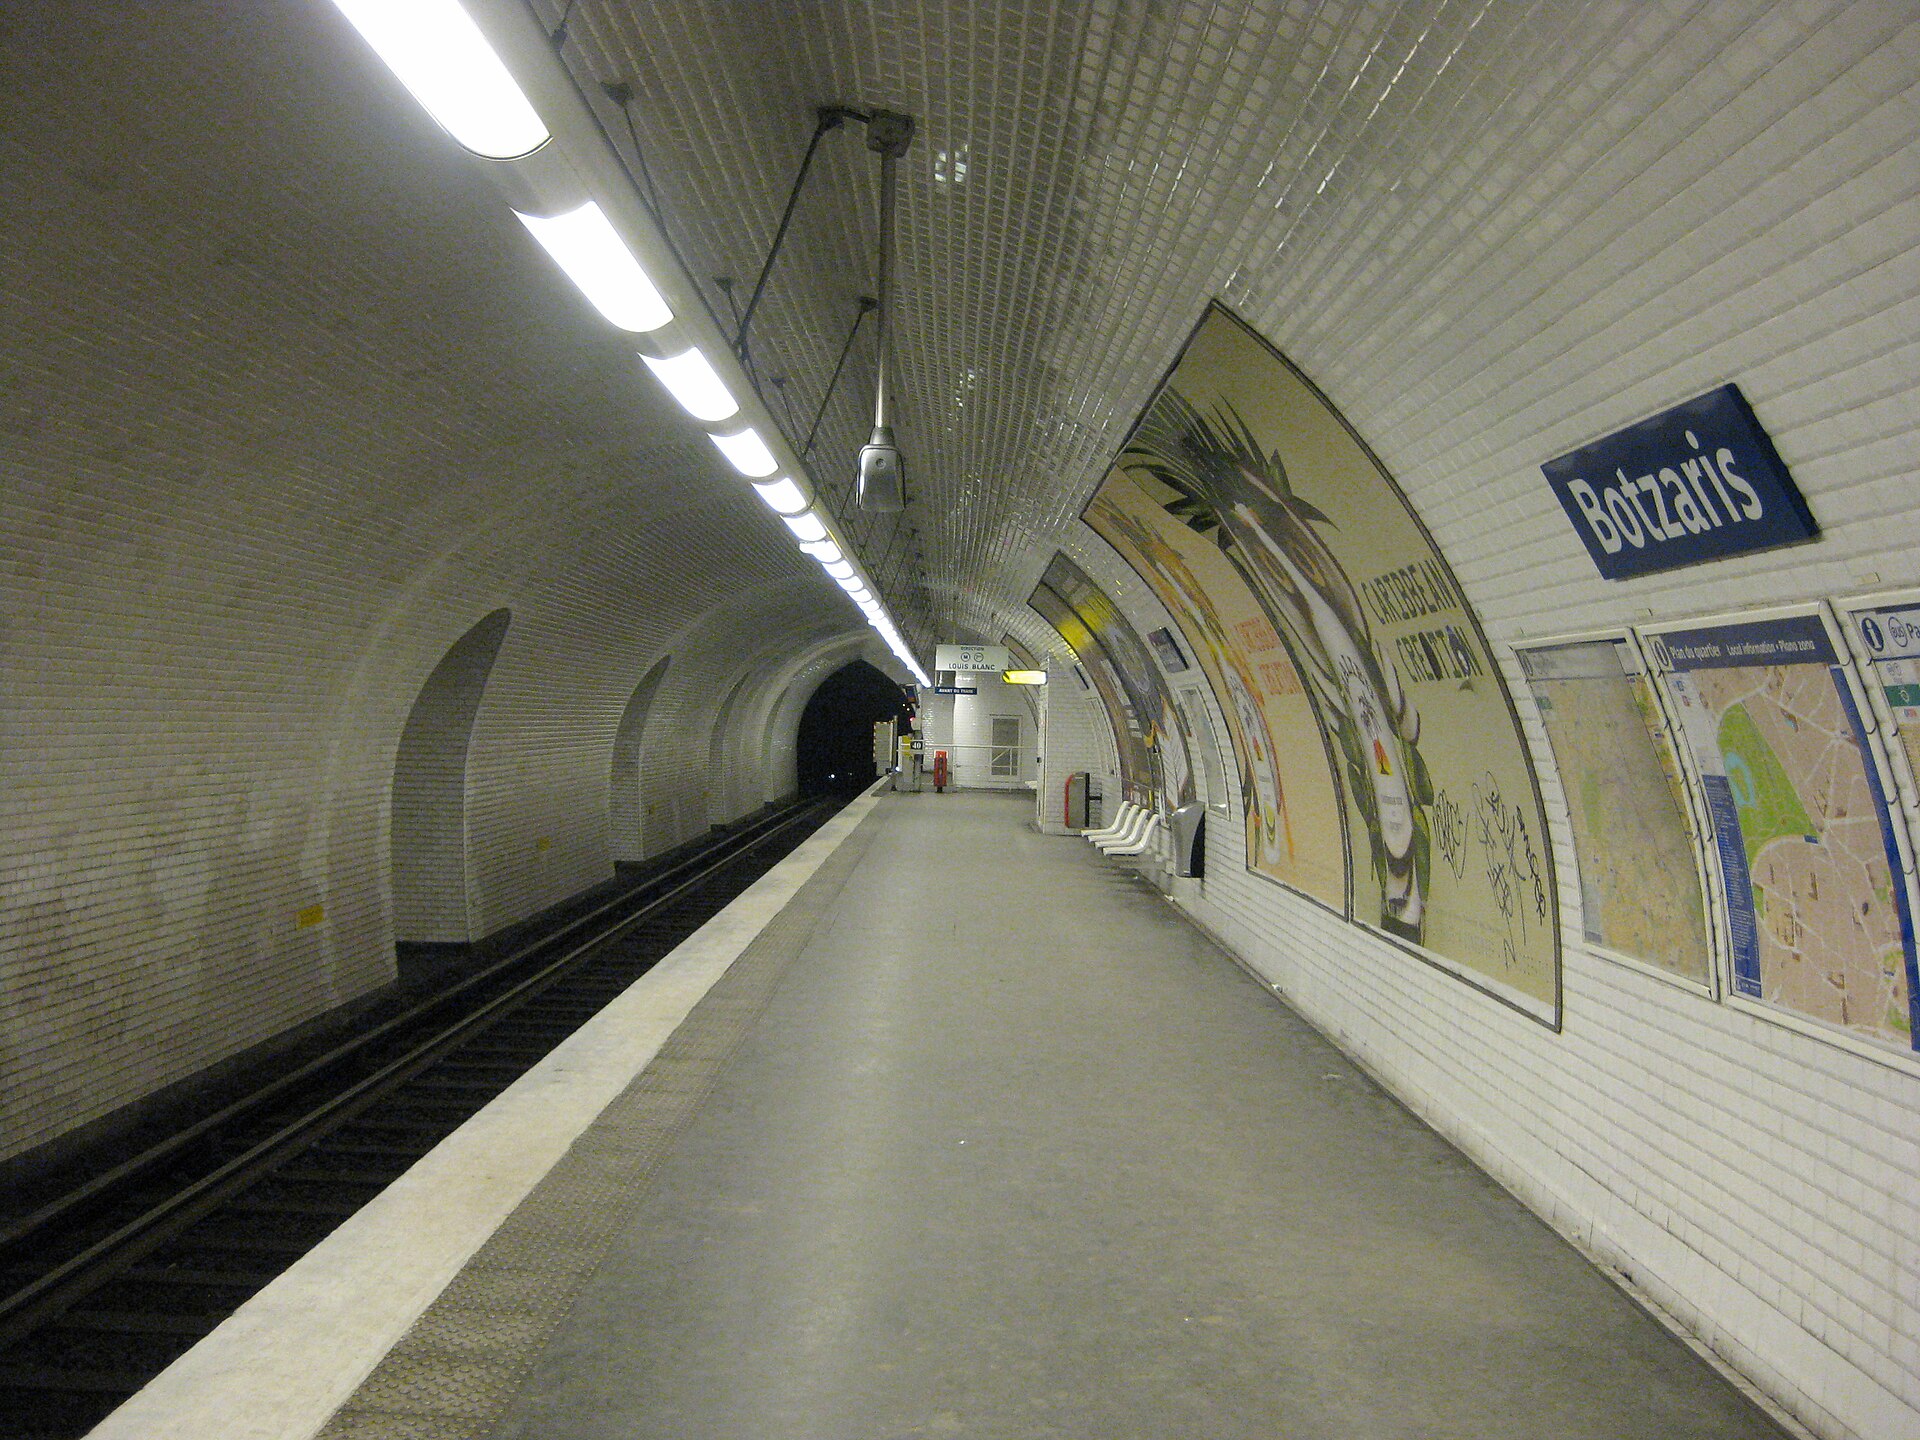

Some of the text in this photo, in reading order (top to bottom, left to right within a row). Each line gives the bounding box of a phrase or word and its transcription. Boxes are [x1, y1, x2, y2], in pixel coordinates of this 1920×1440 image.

[1567, 430, 1763, 554] Botzaris
[1361, 558, 1457, 625] CARIBBEAN
[912, 741, 922, 750] 40
